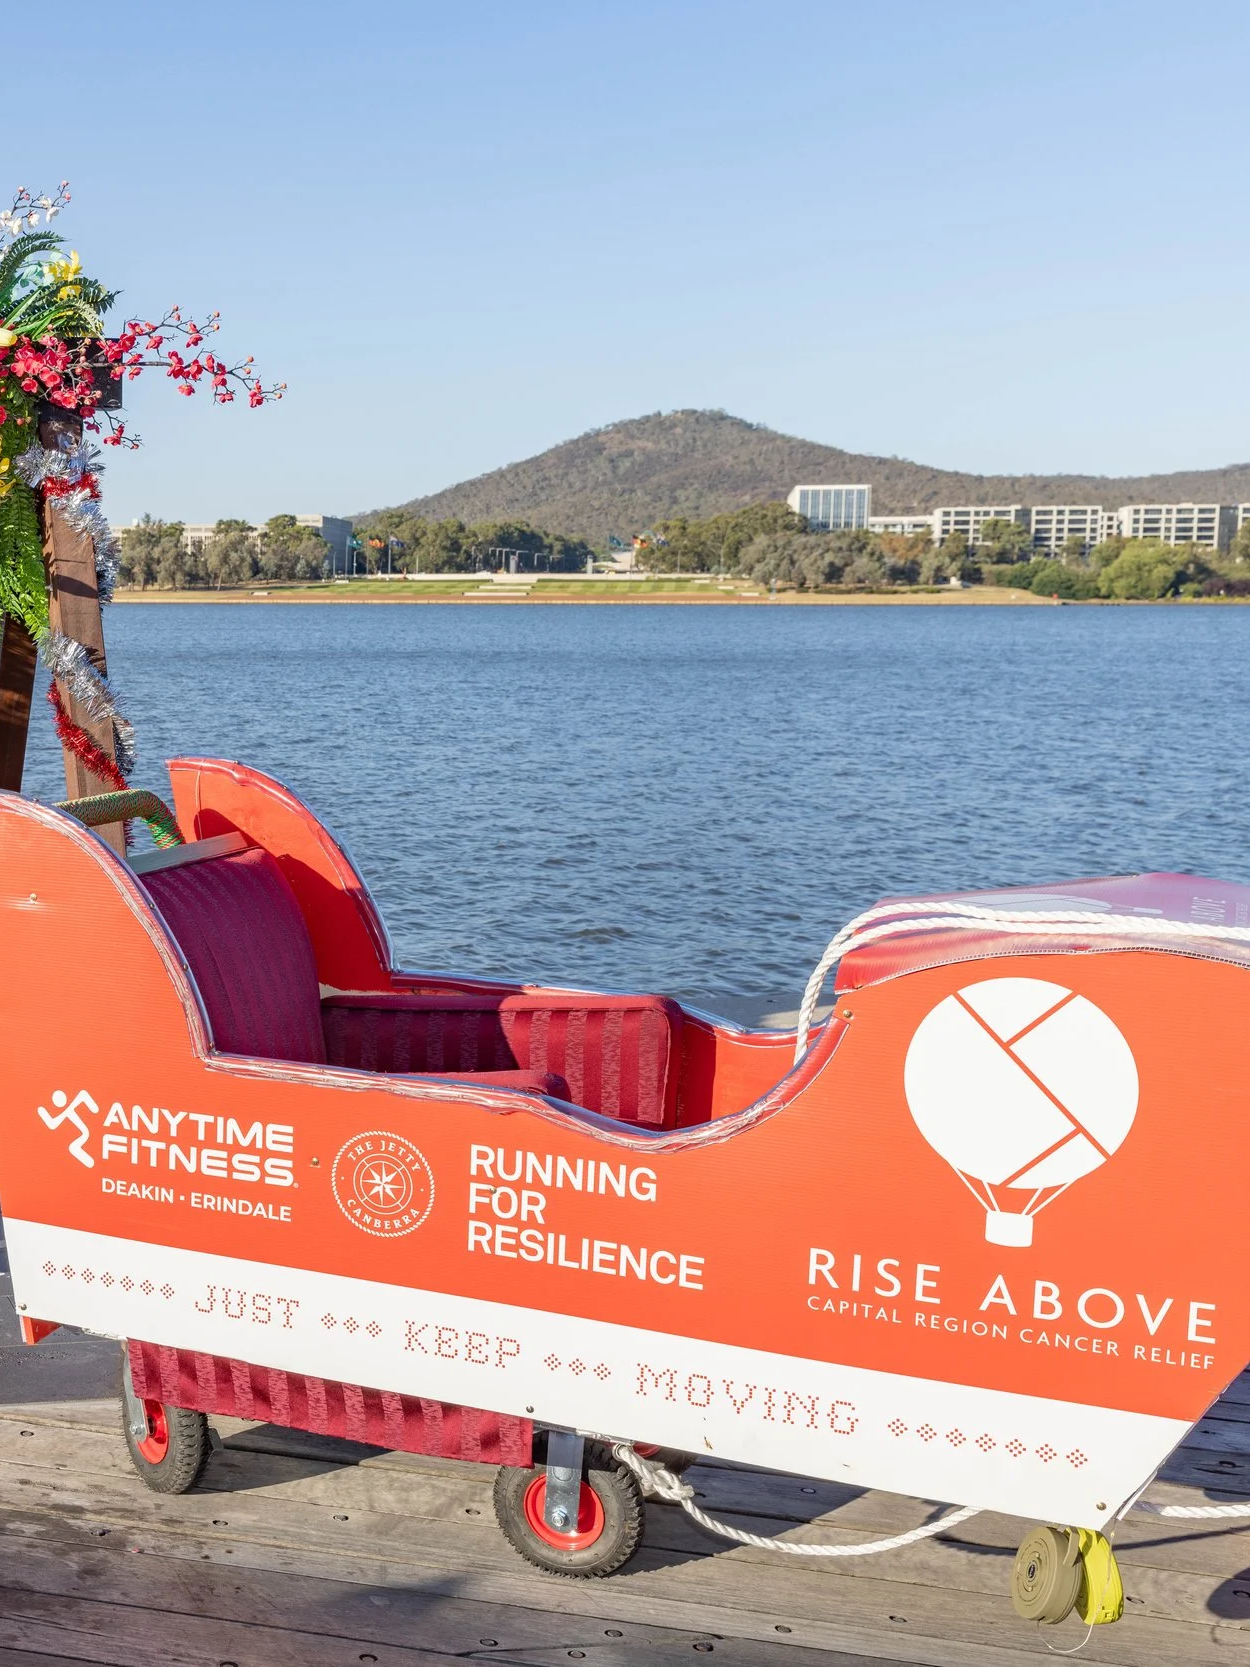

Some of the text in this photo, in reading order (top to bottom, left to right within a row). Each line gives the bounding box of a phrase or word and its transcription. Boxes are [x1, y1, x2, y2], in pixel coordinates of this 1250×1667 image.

[103, 1102, 294, 1153] ANYTIME
[102, 1133, 294, 1187] FITNESS
[347, 1140, 421, 1171] THE JETTY
[470, 1143, 657, 1202] RUNNING
[102, 1177, 292, 1222] DEAKIN ERINDALE
[347, 1199, 420, 1230] CANBERRA
[468, 1182, 547, 1225] FOR
[467, 1220, 705, 1291] RESILIENCE
[808, 1247, 1216, 1345] RISE ABOVE
[807, 1295, 1215, 1370] CAPITAL REGION CANCER RELIEF
[195, 1285, 859, 1435] JUST KEEP MOVING
